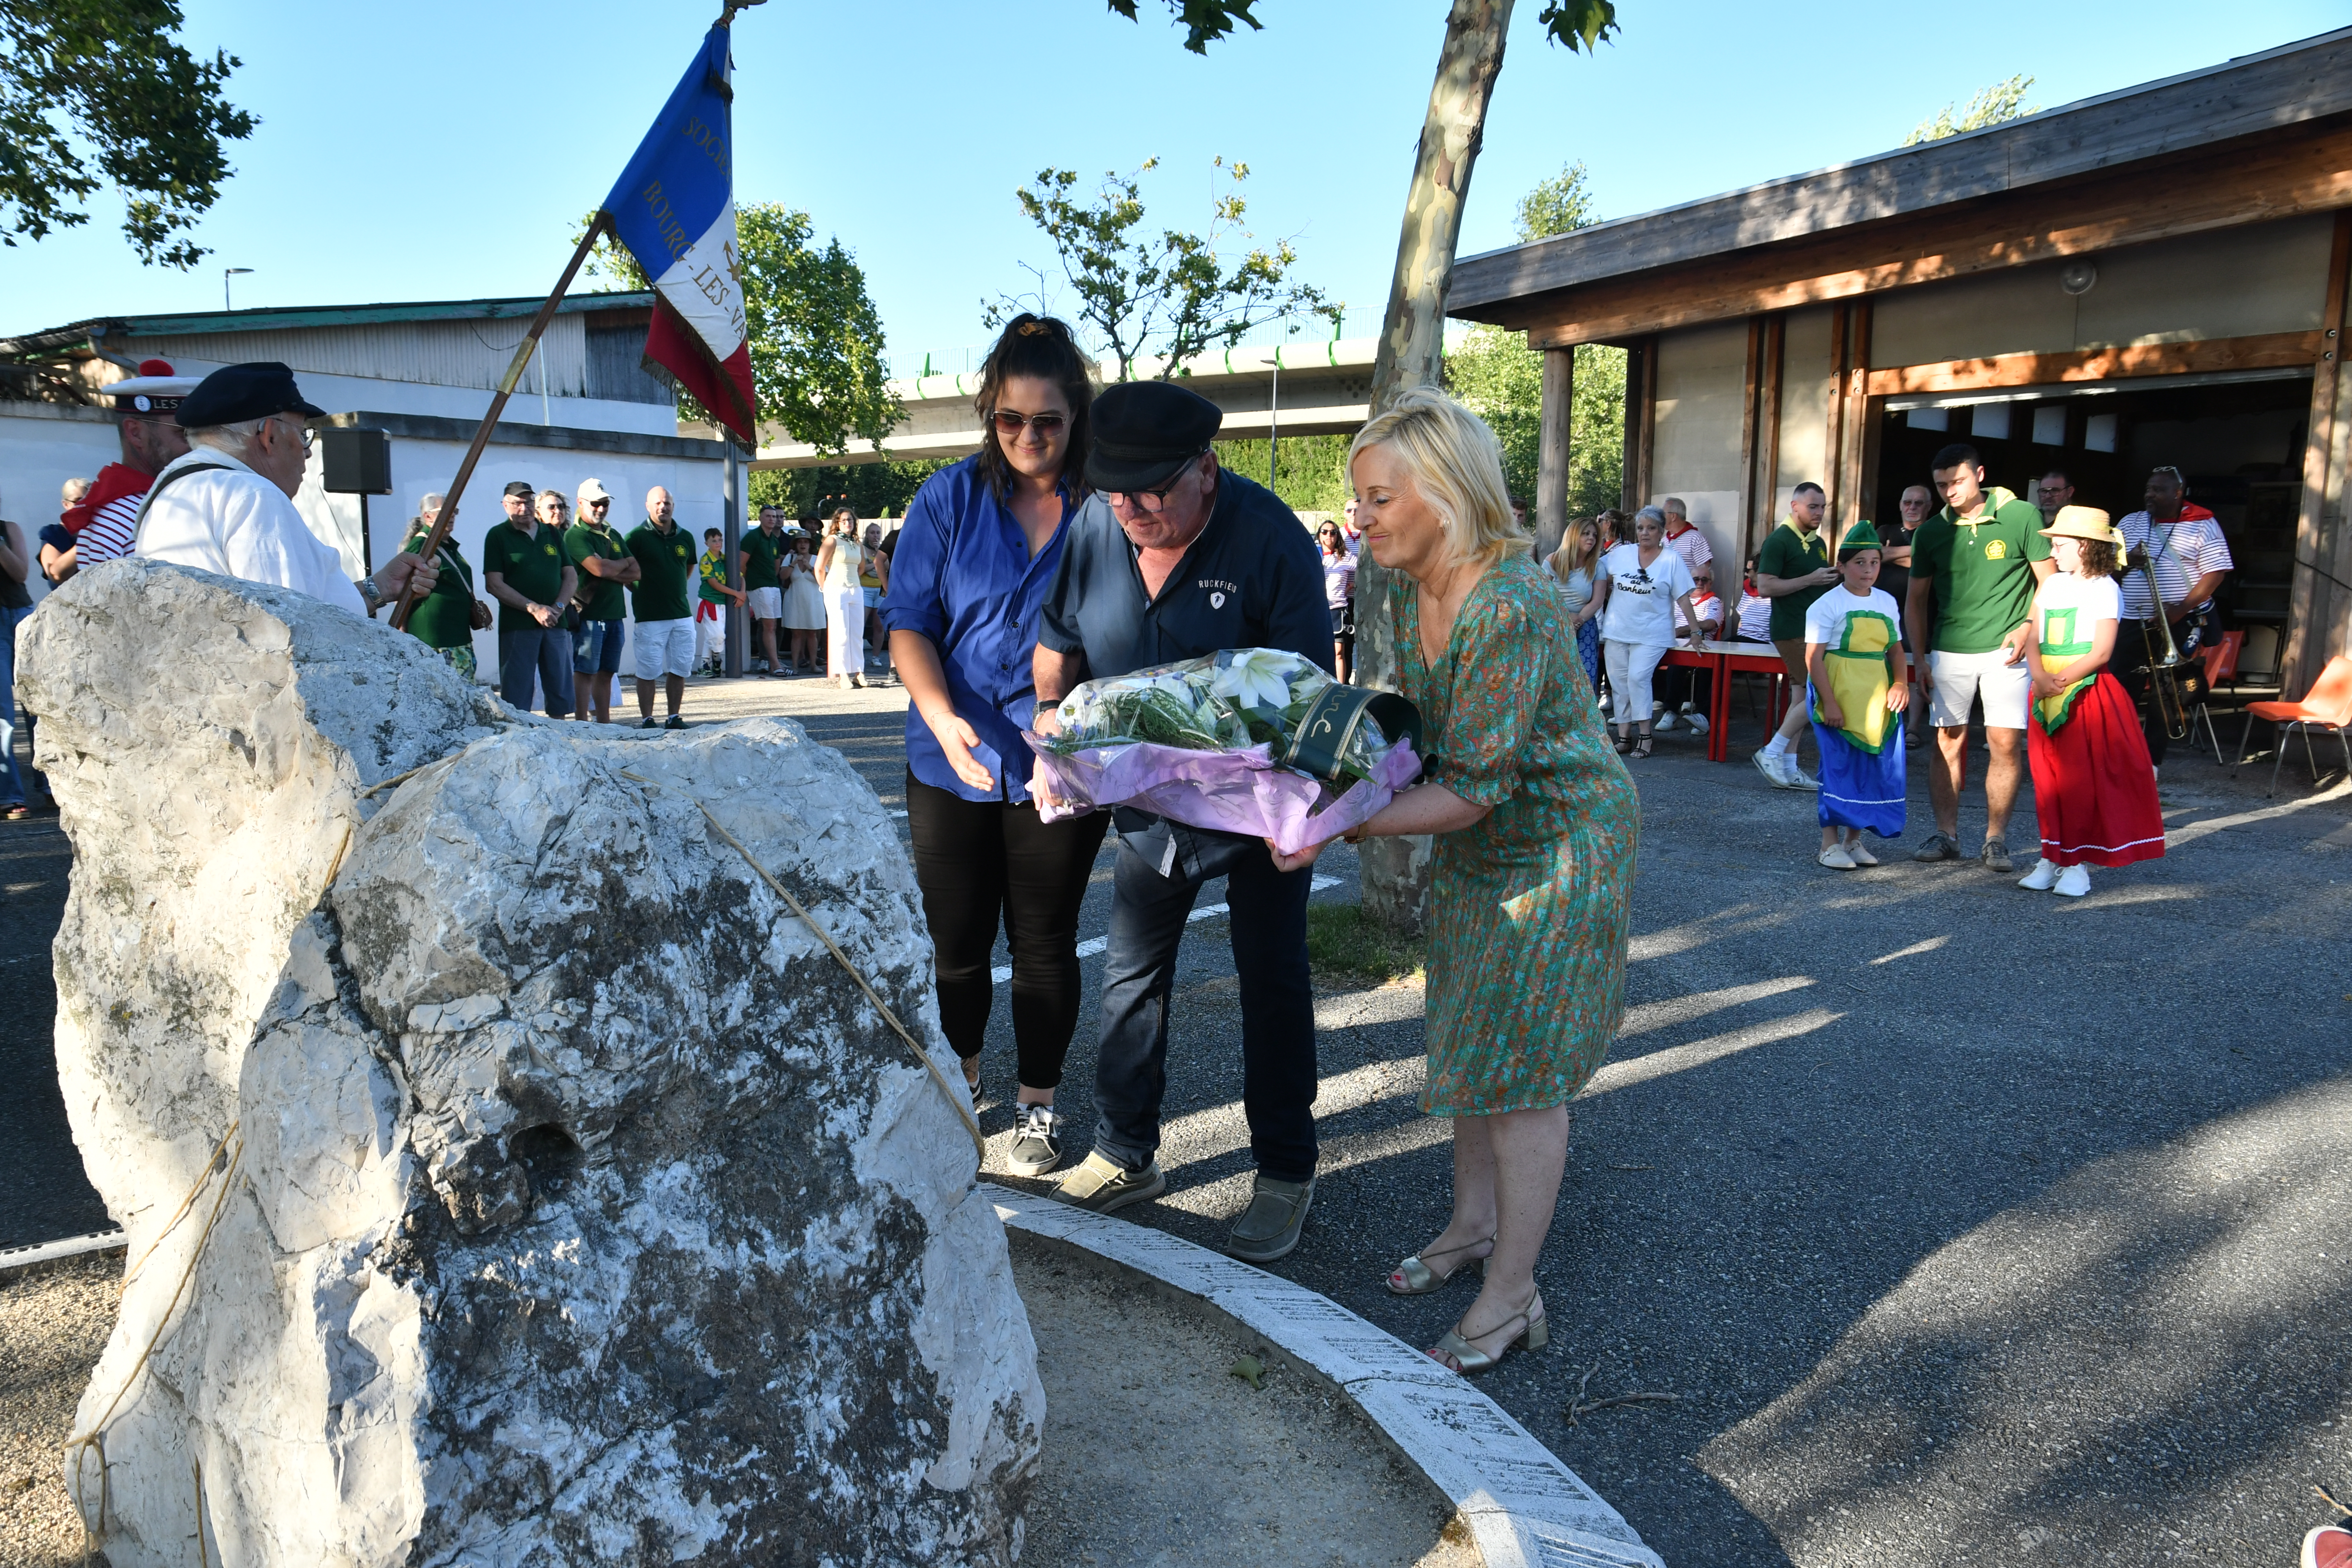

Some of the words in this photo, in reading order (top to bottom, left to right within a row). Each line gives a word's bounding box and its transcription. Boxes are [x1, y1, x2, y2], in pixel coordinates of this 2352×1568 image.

[682, 116, 730, 182] SOCIE
[154, 399, 178, 409] LES
[1198, 580, 1237, 593] RUCKFIELD
